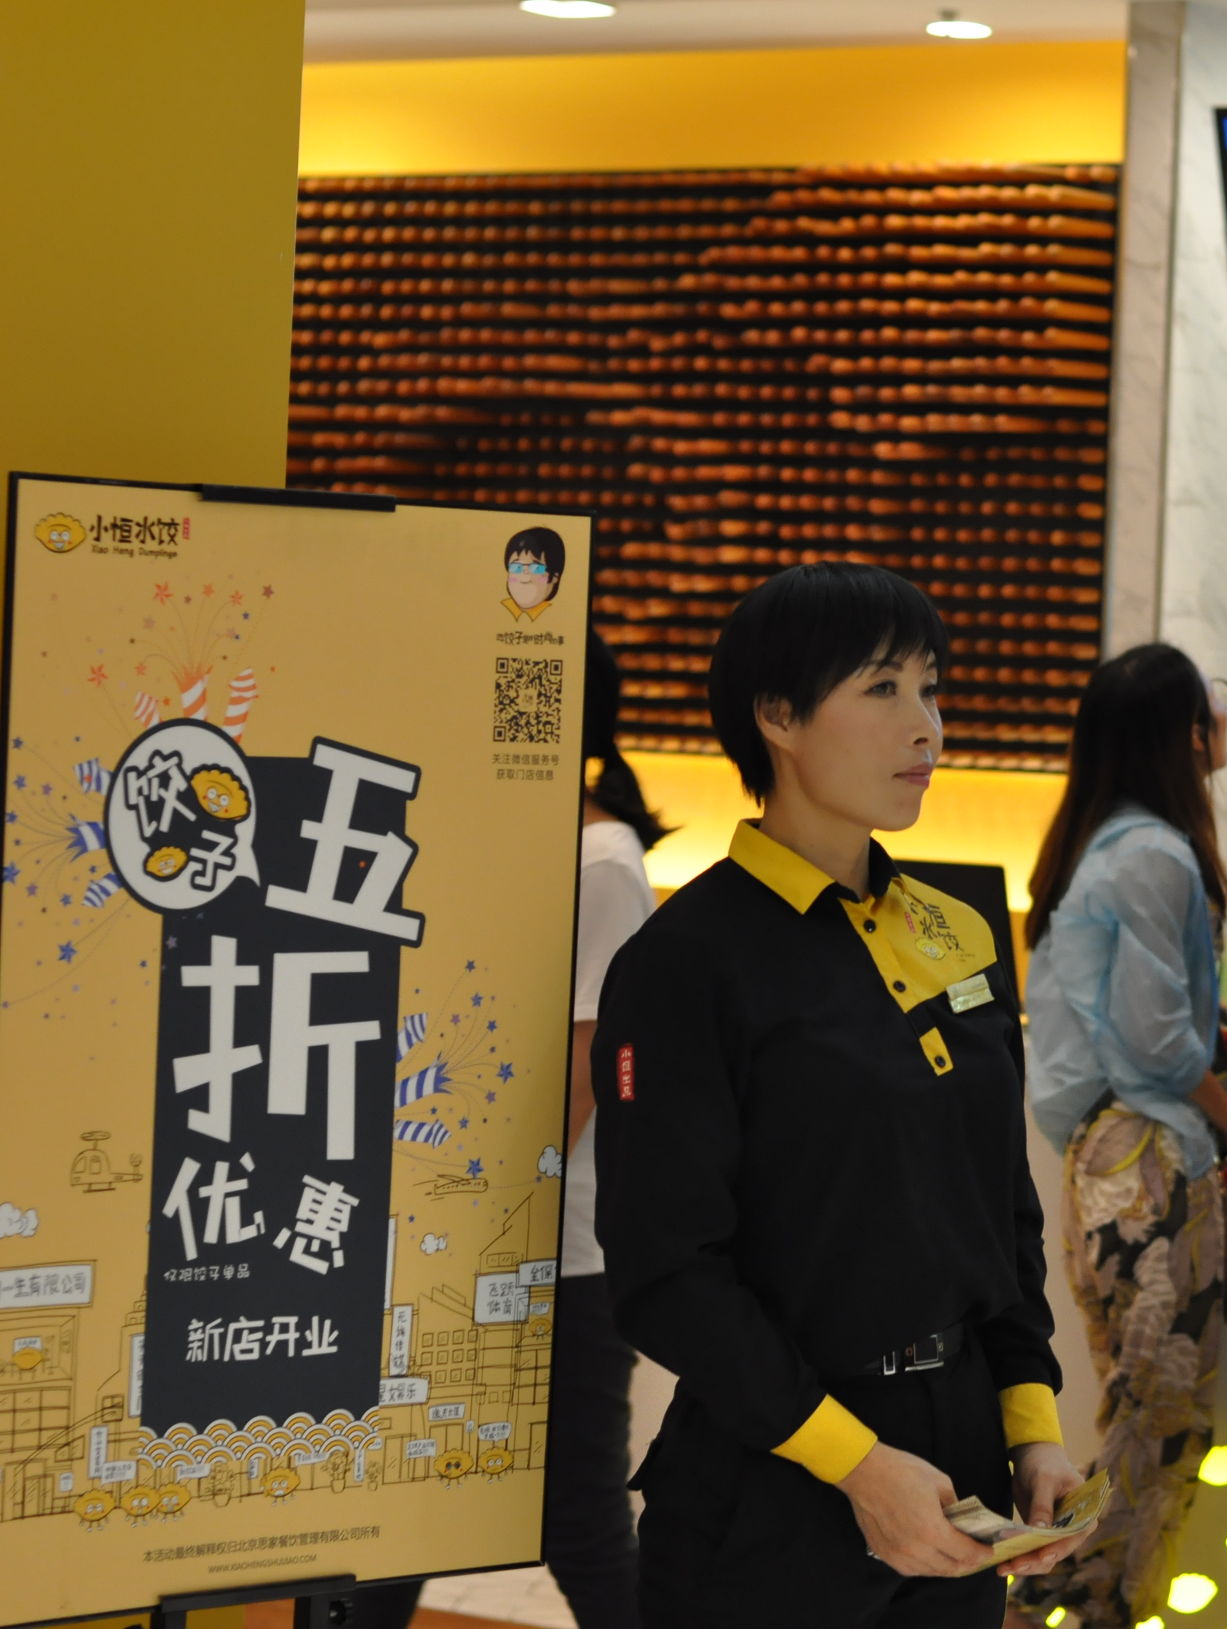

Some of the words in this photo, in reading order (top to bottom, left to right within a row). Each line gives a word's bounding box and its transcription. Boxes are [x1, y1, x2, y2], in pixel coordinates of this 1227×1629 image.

[89, 515, 180, 546] 小恒水饺
[163, 1153, 360, 1274] 优惠
[163, 1264, 250, 1281] 仅限饺子单品
[186, 1315, 339, 1362] 新店开业
